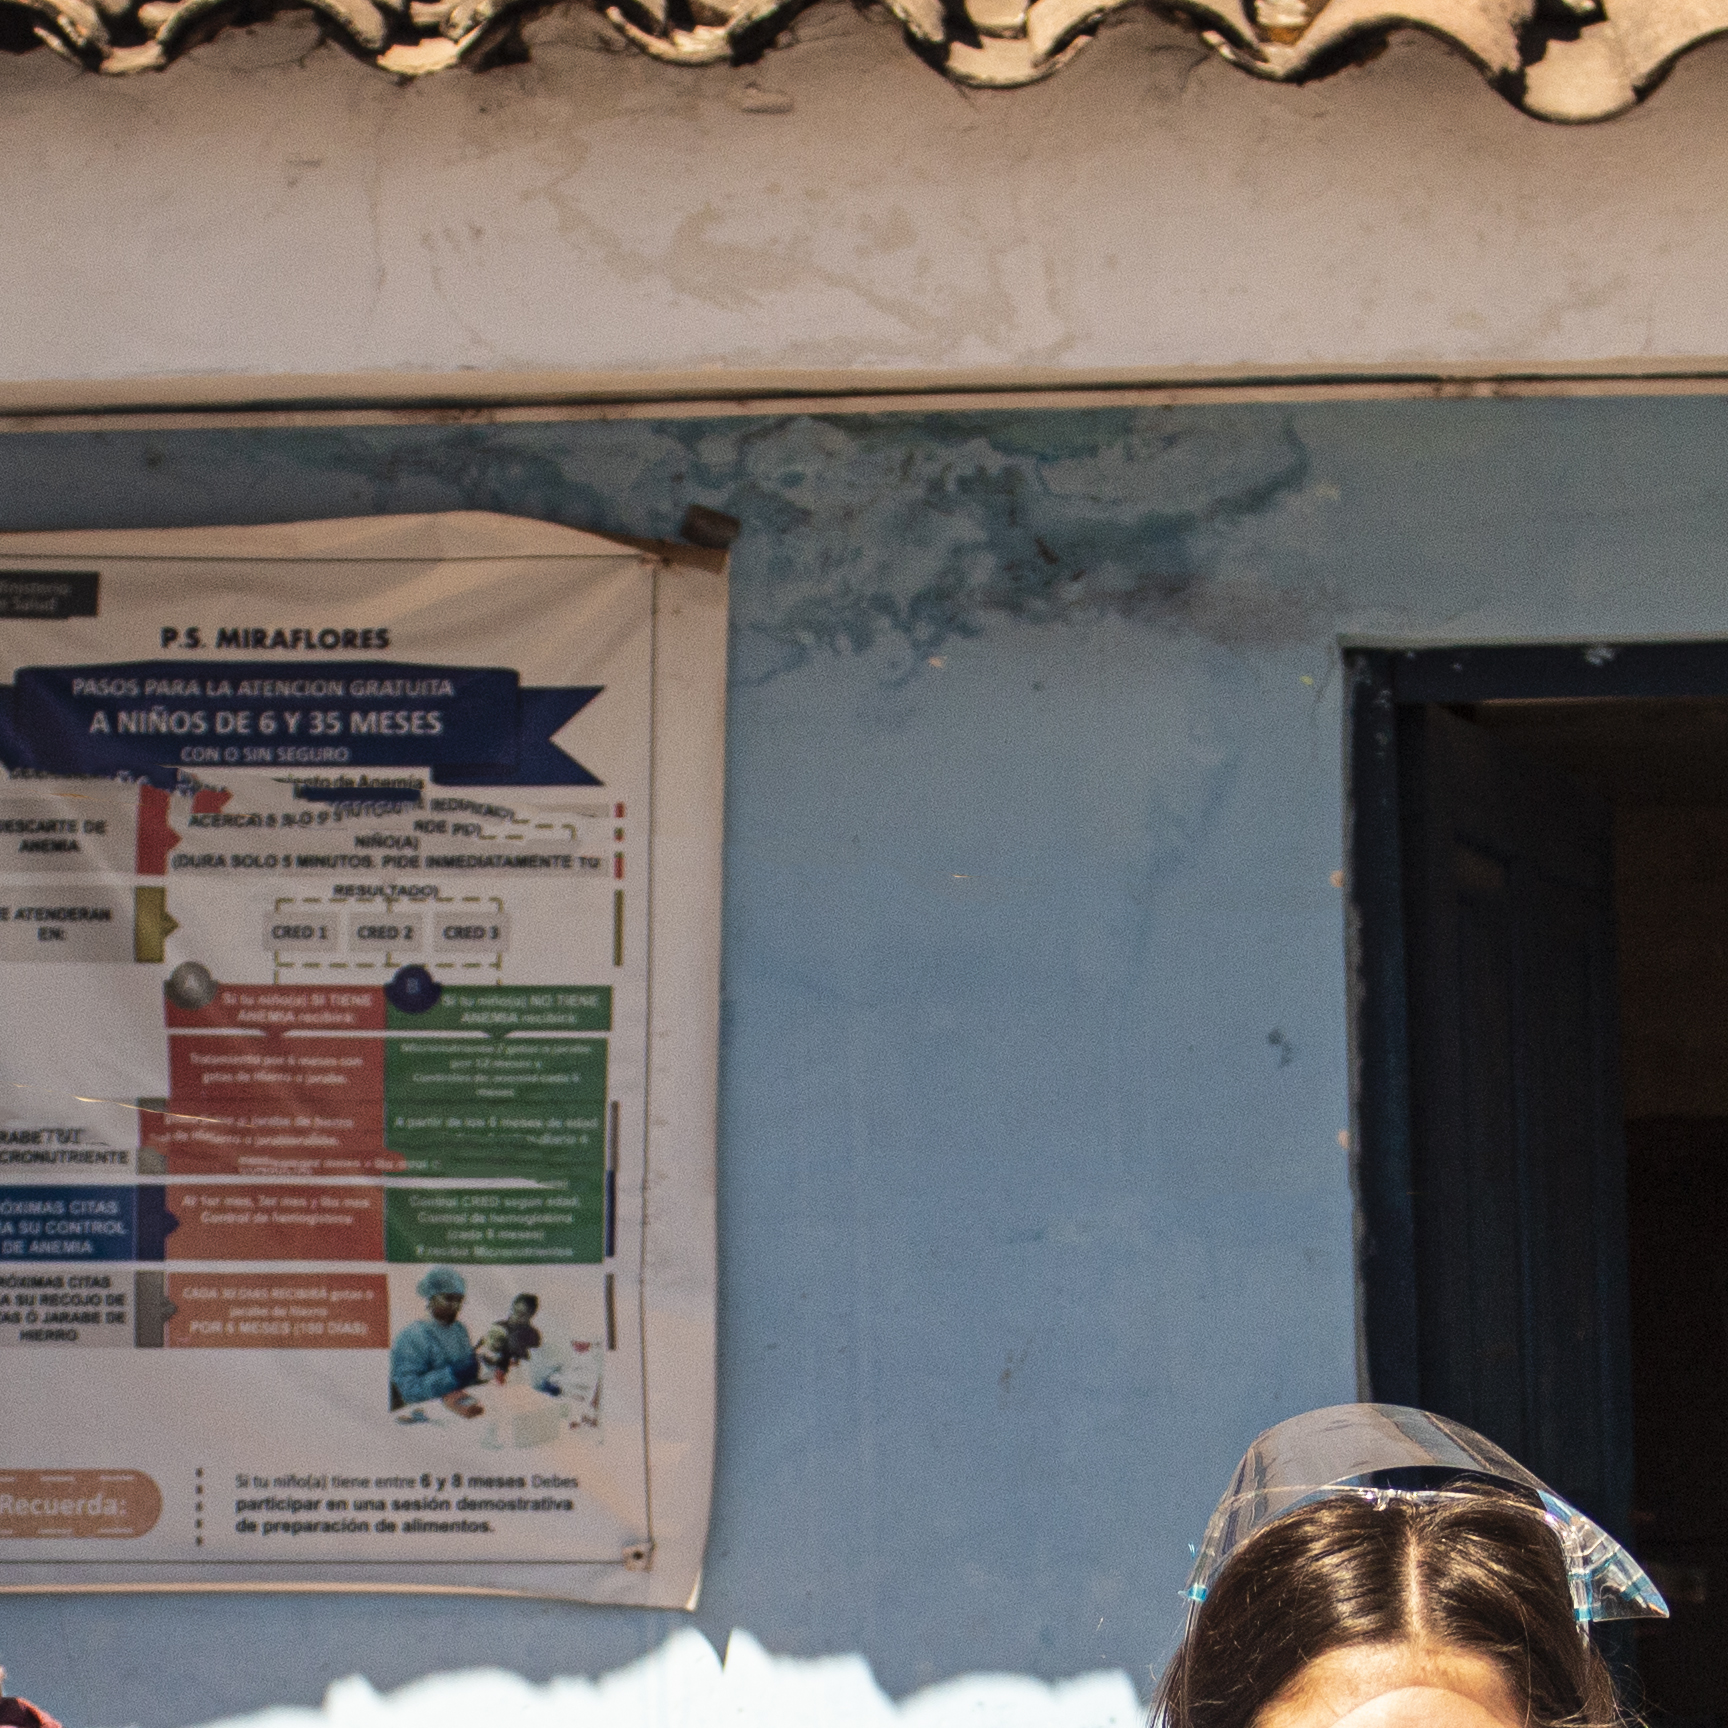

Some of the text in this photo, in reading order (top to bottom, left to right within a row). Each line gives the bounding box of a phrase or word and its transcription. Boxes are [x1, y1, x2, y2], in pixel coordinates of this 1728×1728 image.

[160, 624, 391, 650] P.S. MIRAFLORES
[72, 676, 456, 698] PASOS PARA LA ATENCION GRATUITA
[89, 702, 444, 736] A NIÑOS DE 6 Y 35 MESES
[179, 744, 352, 763] CON O SIN SEGURO
[82, 818, 107, 835] DE
[13, 906, 113, 923] ATENDERAN
[272, 924, 313, 941] CRED
[357, 924, 398, 941] CRED
[443, 924, 484, 941] CRED
[70, 1200, 120, 1216] CITAS
[19, 1220, 41, 1235] SU
[44, 1220, 127, 1235] CONTROL
[1, 1240, 94, 1256] DE ANEMIA
[68, 1275, 112, 1289] CITAS
[15, 1293, 37, 1307] SU
[39, 1293, 104, 1307] RECOJO
[105, 1293, 127, 1307] DE
[41, 1311, 102, 1326] JARABE
[105, 1311, 127, 1326] DE
[235, 1473, 581, 1491] Si tu niño(a) tiene entre 6 y 8 meses Debes
[235, 1497, 576, 1514] participar en una sesión demostrativa
[234, 1517, 496, 1536] de preparación de alimentos.
